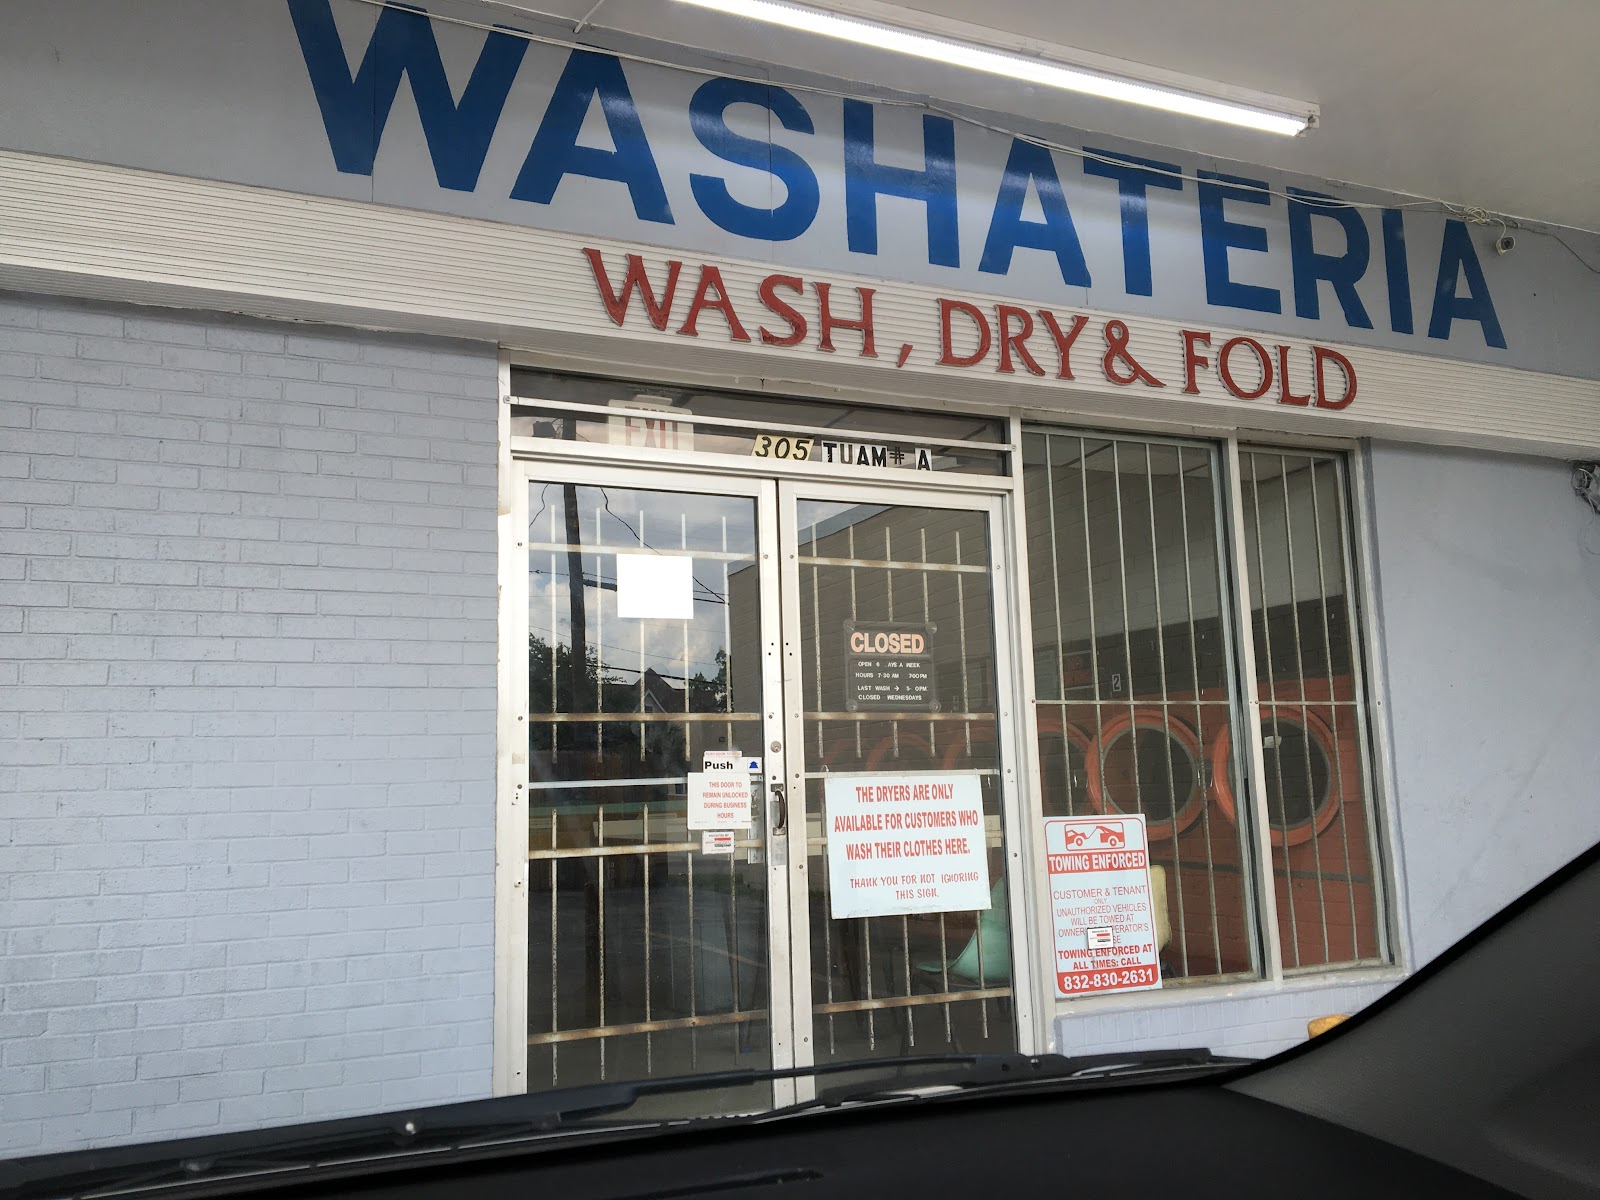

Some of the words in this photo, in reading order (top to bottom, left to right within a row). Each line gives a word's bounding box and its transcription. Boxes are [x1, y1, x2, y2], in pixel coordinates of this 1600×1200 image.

[287, 0, 1507, 349] WASHATERIA
[581, 247, 914, 367] WASH,
[937, 296, 1090, 380] DRY
[1102, 319, 1167, 389] &
[1179, 327, 1358, 411] FOLD
[754, 436, 811, 460] 305
[917, 449, 931, 470] A
[850, 632, 925, 653] CLOSED
[704, 761, 734, 770] Push
[855, 786, 874, 803] THE
[876, 784, 911, 802] DRYERS
[912, 784, 930, 801] ARE
[931, 783, 954, 800] ONLY
[834, 813, 883, 832] AVAILABLE
[885, 813, 902, 830] FOR
[904, 810, 957, 829] CUSTOMERS
[958, 809, 979, 826] WHO
[846, 842, 873, 860] WASH
[874, 841, 901, 858] THEIR
[903, 839, 943, 857] CLOTHES
[944, 837, 971, 855] HERE.
[1049, 854, 1090, 872] TOWING
[1091, 852, 1145, 869] ENFORCED
[850, 877, 878, 889] THANK
[880, 876, 898, 886] YOU
[901, 874, 917, 885] FOR
[920, 873, 936, 884] NOT
[941, 871, 979, 884] IGNORING
[895, 889, 914, 900] THIS
[1053, 888, 1103, 900] CUSTOMER
[1104, 887, 1111, 896] &
[1112, 885, 1147, 896] TENANT
[1056, 904, 1111, 917] UNAUTHORIZED
[1112, 902, 1147, 913] VEHICLES
[1070, 917, 1087, 926] WILL
[1088, 916, 1098, 925] BE
[1099, 914, 1125, 924] TOWED
[1126, 914, 1135, 922] AT
[1058, 948, 1093, 960] TOWING
[1095, 945, 1141, 957] ENFORCED
[1142, 944, 1153, 953] AT
[1073, 962, 1089, 970] ALL
[1091, 959, 1119, 970] TIMES:
[1120, 956, 1142, 966] CALL
[1063, 968, 1153, 991] 832-830-2631
